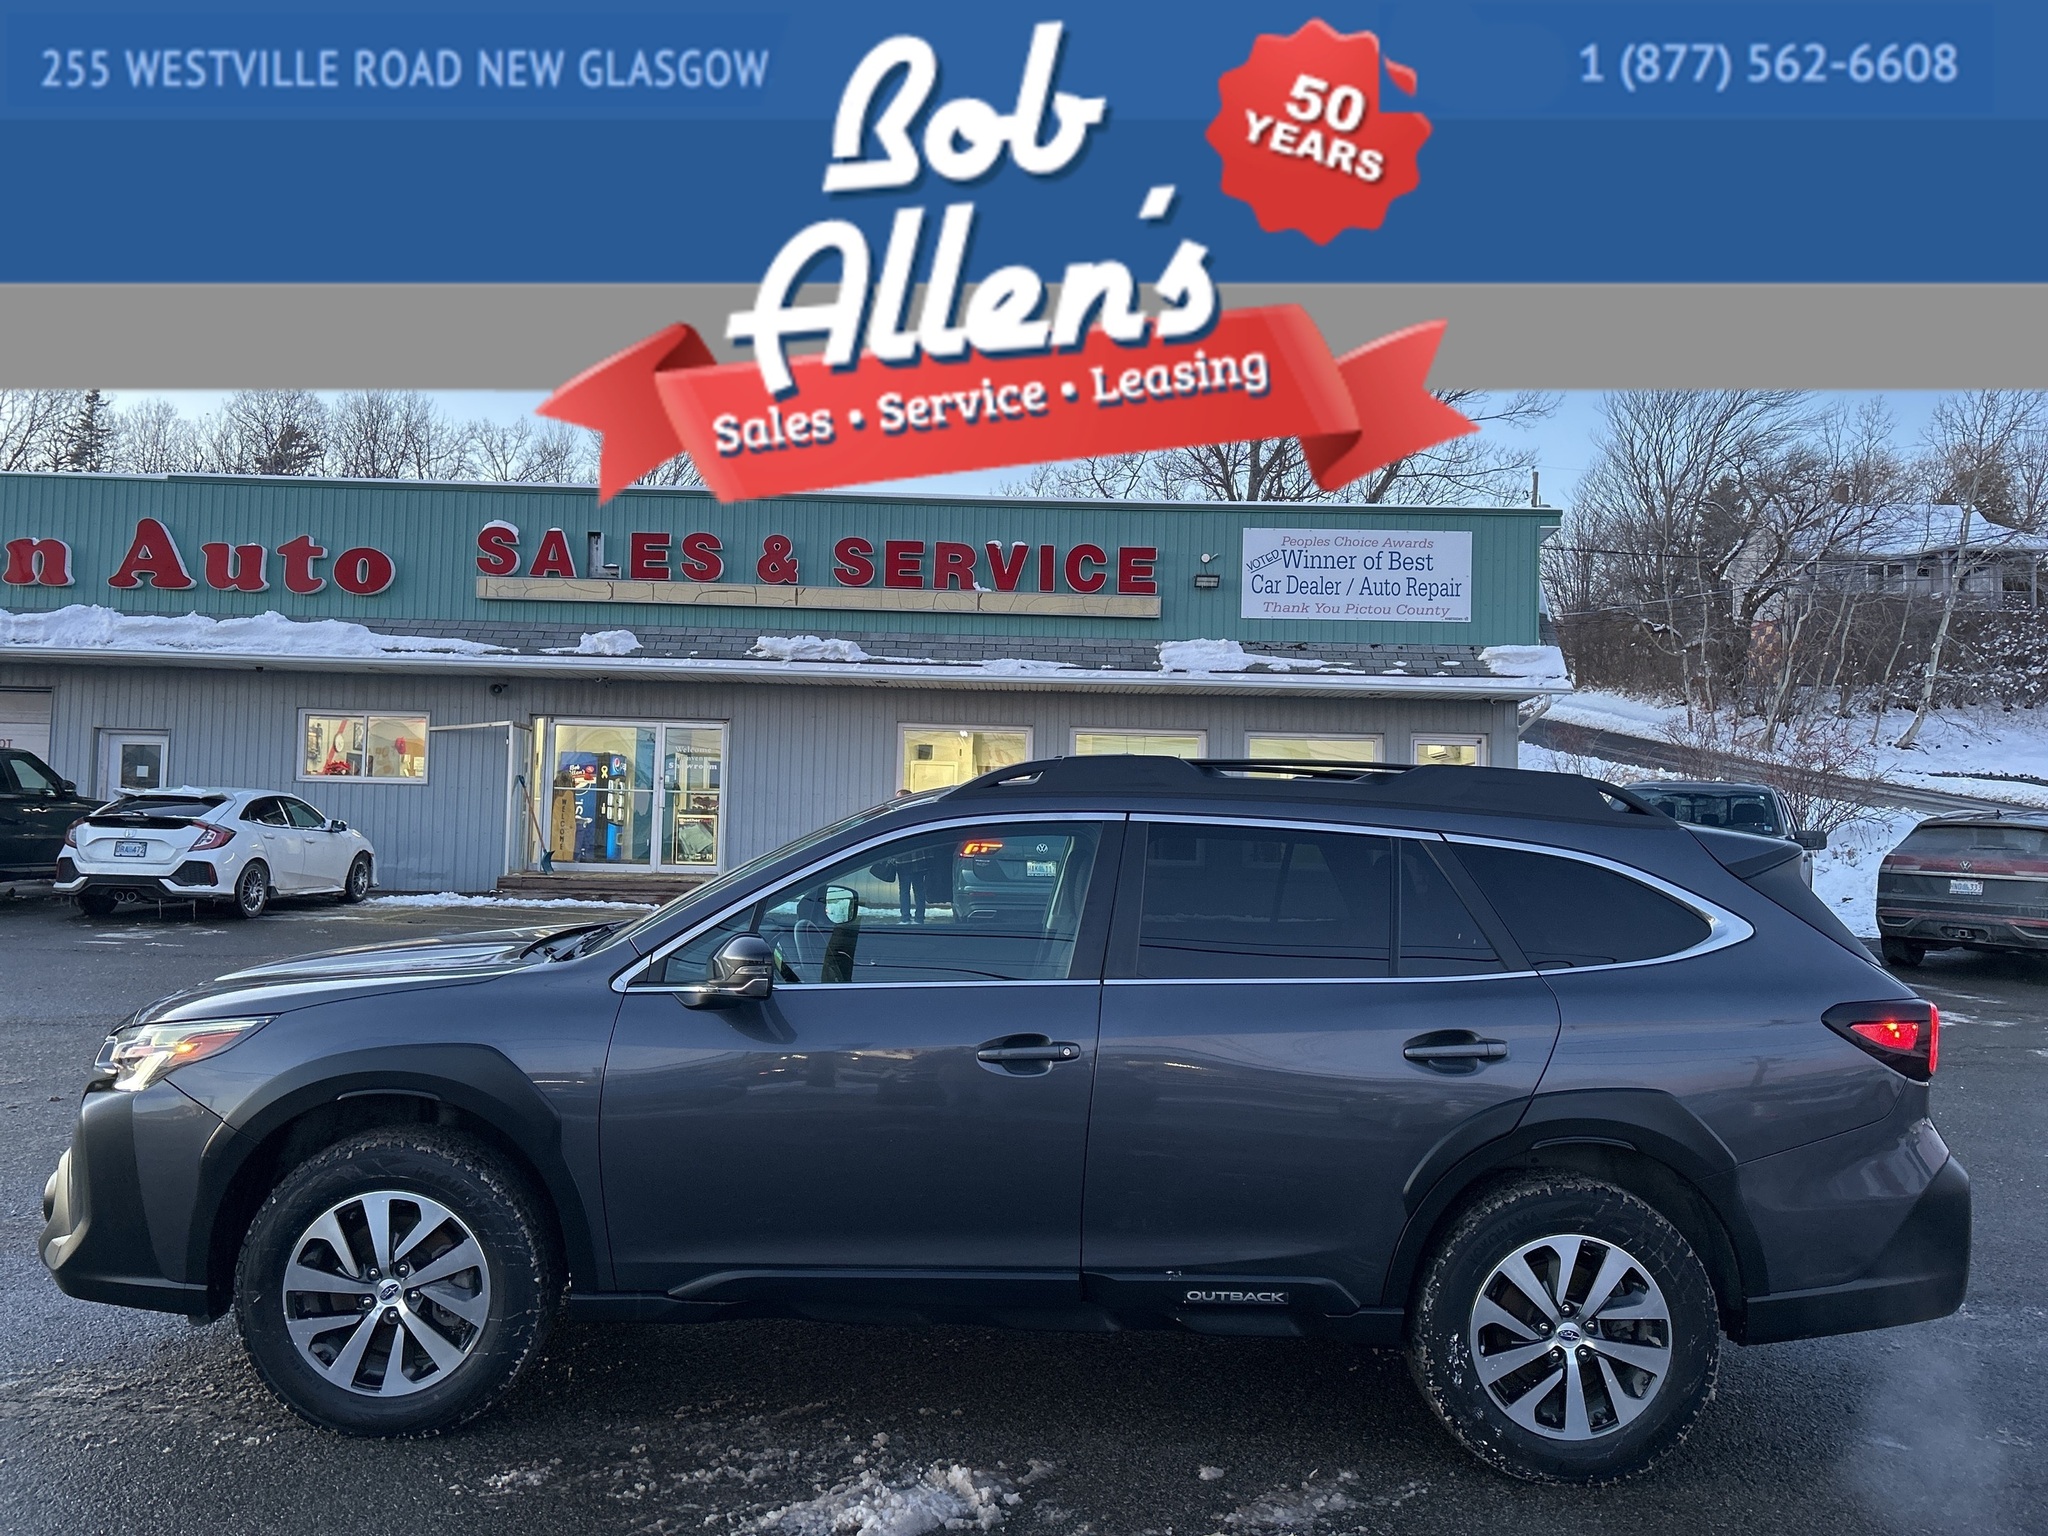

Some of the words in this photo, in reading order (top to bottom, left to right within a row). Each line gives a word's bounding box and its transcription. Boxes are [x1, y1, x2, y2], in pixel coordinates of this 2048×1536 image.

[1281, 536, 1331, 548] Peoples
[1334, 536, 1379, 548] Choice
[1382, 537, 1434, 549] Awards
[107, 516, 396, 595] Auto
[756, 534, 799, 584] &
[833, 536, 1159, 595] SERVICE
[1246, 549, 1280, 571] VOTED
[1281, 549, 1357, 570] Winner
[1363, 551, 1384, 571] of
[1388, 551, 1434, 572] Best
[1251, 574, 1281, 595] Car
[1286, 575, 1342, 596] Dealer
[1359, 576, 1401, 597] Auto
[1406, 577, 1462, 602] Repair
[1263, 601, 1310, 614] Thank
[1315, 602, 1341, 615] You
[1344, 603, 1392, 616] Pictou
[1396, 603, 1451, 618] County
[675, 745, 712, 753] Welcome
[1186, 1291, 1285, 1303] OUTBACK
